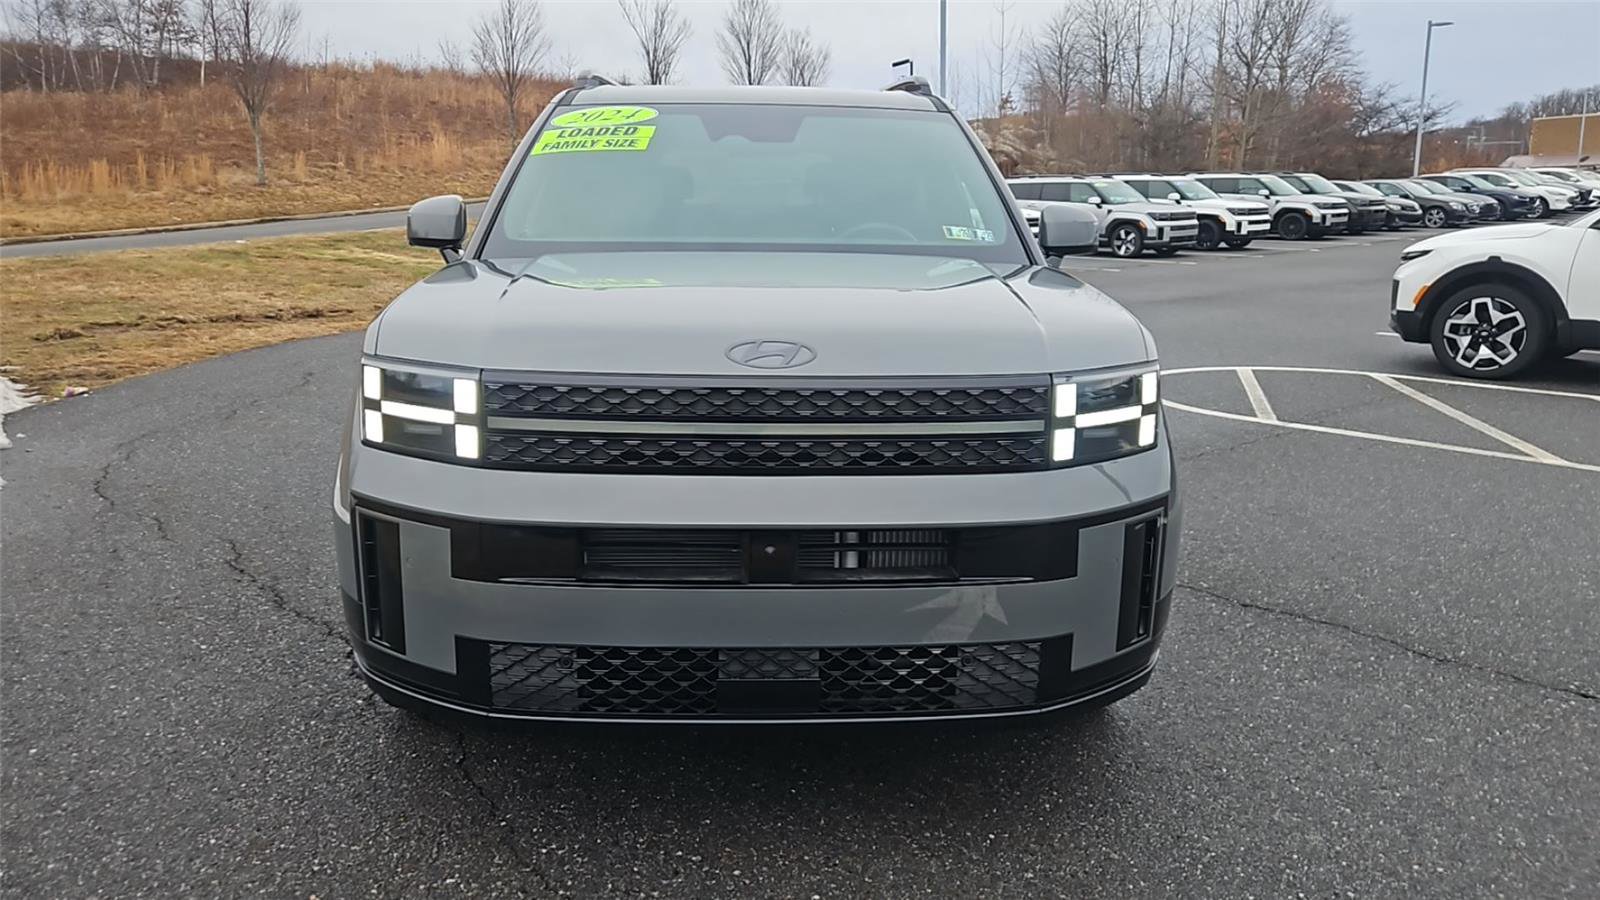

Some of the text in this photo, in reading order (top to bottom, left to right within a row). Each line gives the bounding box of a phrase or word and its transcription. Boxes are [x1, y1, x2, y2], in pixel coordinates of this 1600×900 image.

[568, 109, 642, 123] 2024
[556, 126, 639, 139] LOADED
[541, 138, 639, 151] FAMILY SIZE
